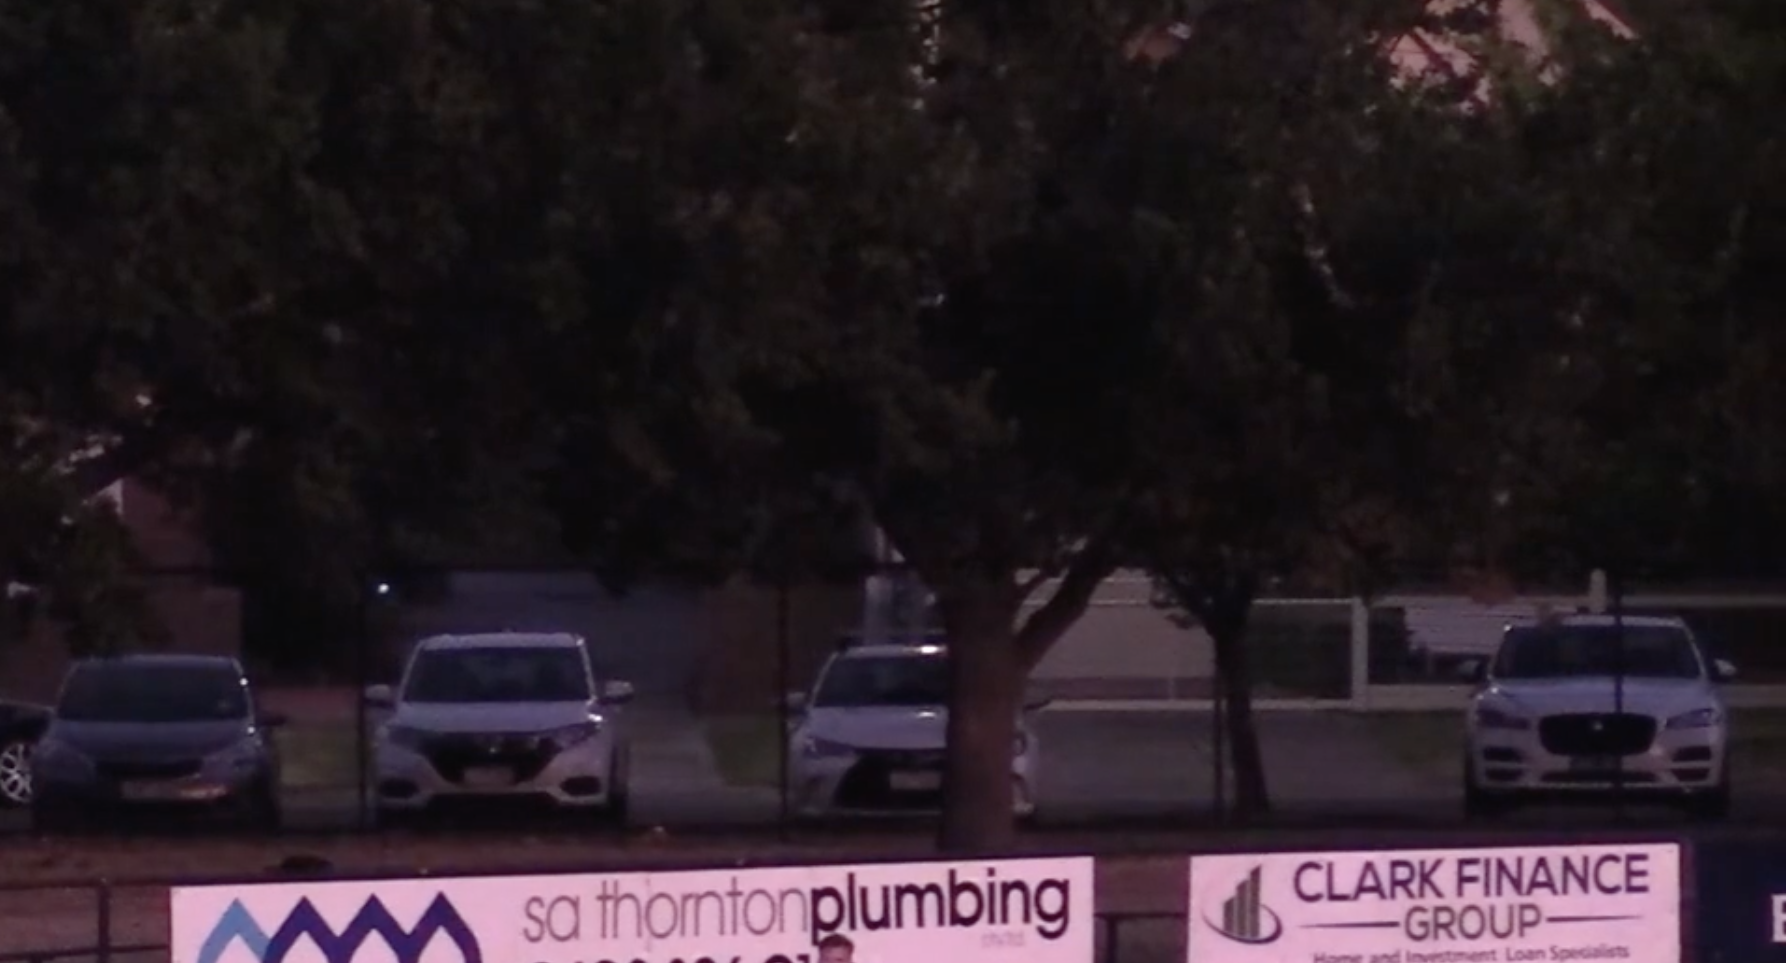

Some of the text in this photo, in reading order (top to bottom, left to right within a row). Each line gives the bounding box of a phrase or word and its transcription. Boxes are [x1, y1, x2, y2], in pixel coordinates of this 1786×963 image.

[1294, 853, 1650, 902] CLARK FINANCE
[523, 893, 581, 943] sa
[1404, 902, 1542, 941] GROUP
[1406, 949, 1497, 963] Investment
[1506, 946, 1543, 962] Loan
[1550, 944, 1630, 962] Specialists
